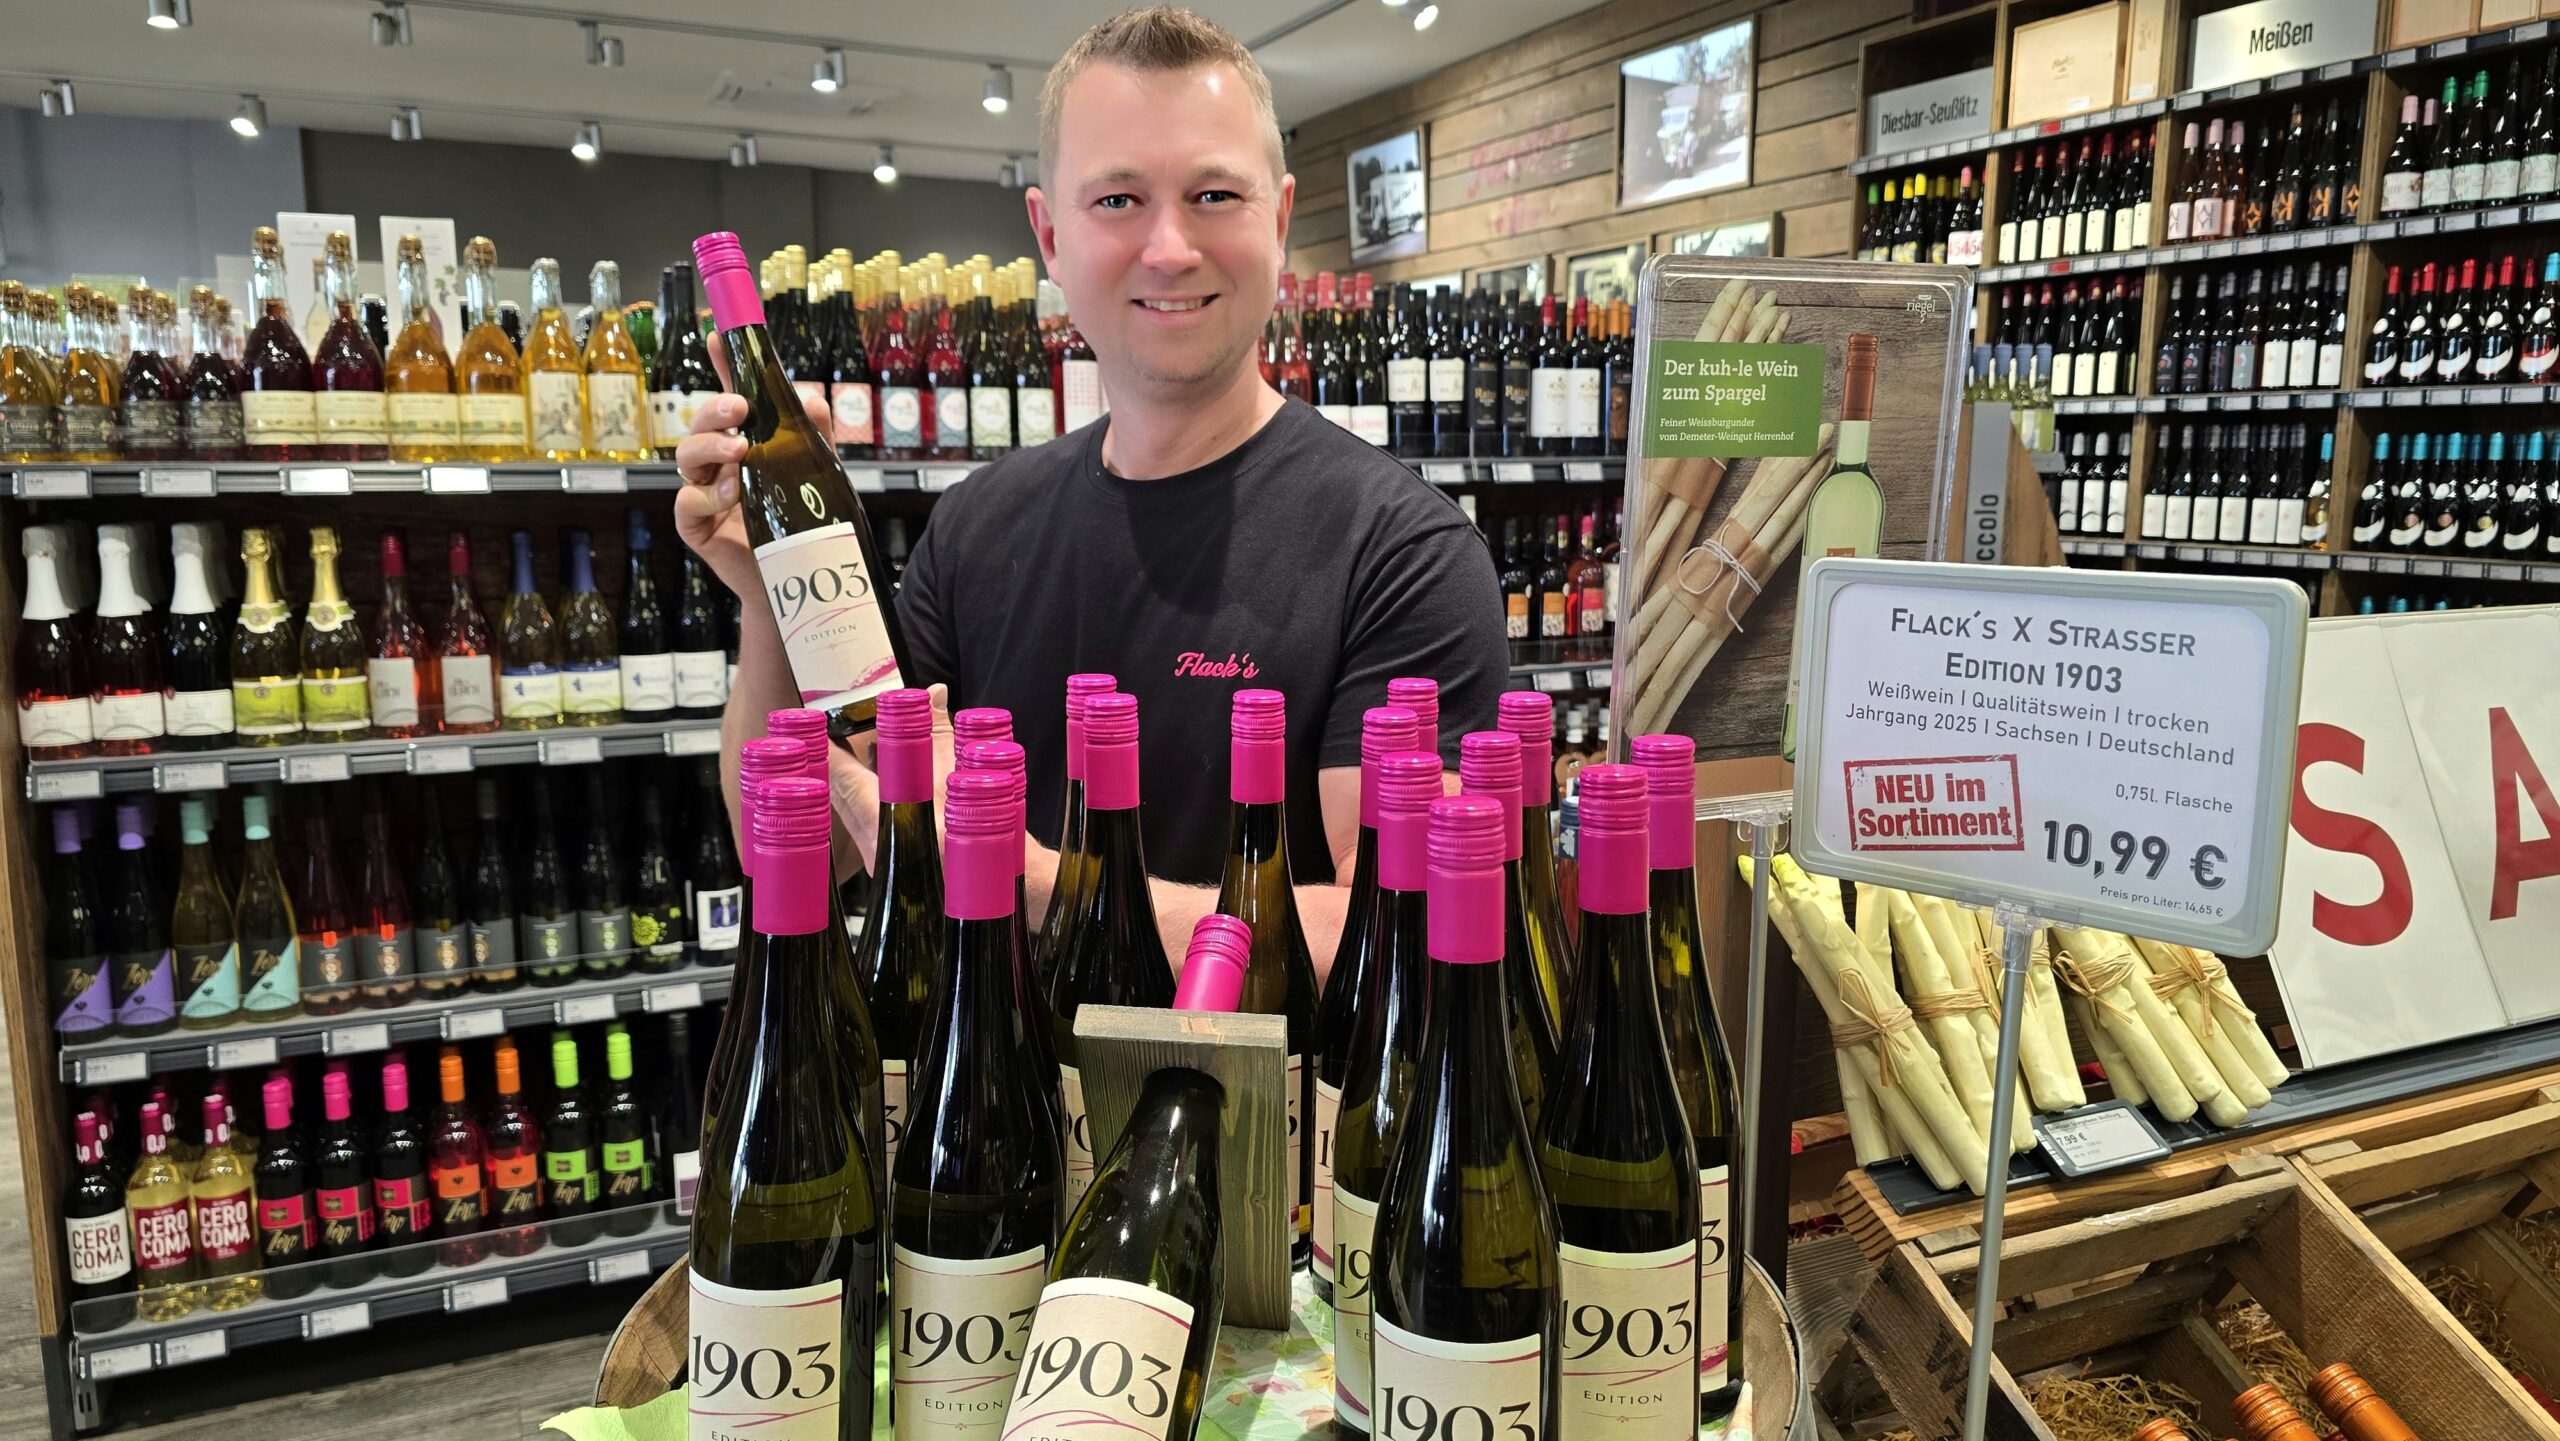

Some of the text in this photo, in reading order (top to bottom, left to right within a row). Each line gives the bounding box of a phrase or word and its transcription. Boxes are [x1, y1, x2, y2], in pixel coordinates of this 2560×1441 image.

[2249, 20, 2313, 55] Meißen
[1881, 95, 1979, 135] Diesbar-Seußlitz
[1664, 358, 1799, 378] Der kuh-le Wein
[1662, 384, 1766, 406] zum Spargel
[1659, 432, 1794, 443] vom Demeter-Weingut Herrenhof
[1660, 417, 1755, 430] Feiner Weissburgunder
[771, 562, 869, 625] 1903
[804, 624, 857, 643] EDITION
[2012, 616, 2033, 643] X
[2055, 662, 2122, 694] 1903
[1868, 681, 1954, 705] Weißwein
[1972, 691, 2106, 723] Qualitätswein
[2127, 708, 2209, 735] trocken
[1846, 703, 1927, 731] Jahrgang
[1934, 713, 1977, 733] 2025
[1995, 721, 2079, 746] Sachsen
[2099, 732, 2234, 766] Deutschland
[1874, 773, 1985, 804] NEU im
[2165, 791, 2232, 813] Flasche
[1858, 806, 2013, 838] Sortiment
[2044, 820, 2227, 890] 10,99 €
[2100, 886, 2223, 917] Preis pro Liter: 14,65 €
[140, 1232, 191, 1259] COMA
[201, 1222, 251, 1249] COMA
[73, 1245, 124, 1270] COMA
[898, 1305, 1037, 1369] 1903
[1562, 1299, 1693, 1360] 1903
[690, 1334, 836, 1400] 1903
[1014, 1336, 1171, 1418] 1903
[925, 1398, 1003, 1413] EDITION
[1584, 1390, 1663, 1406] EDITION
[1380, 1387, 1536, 1441] 1903
